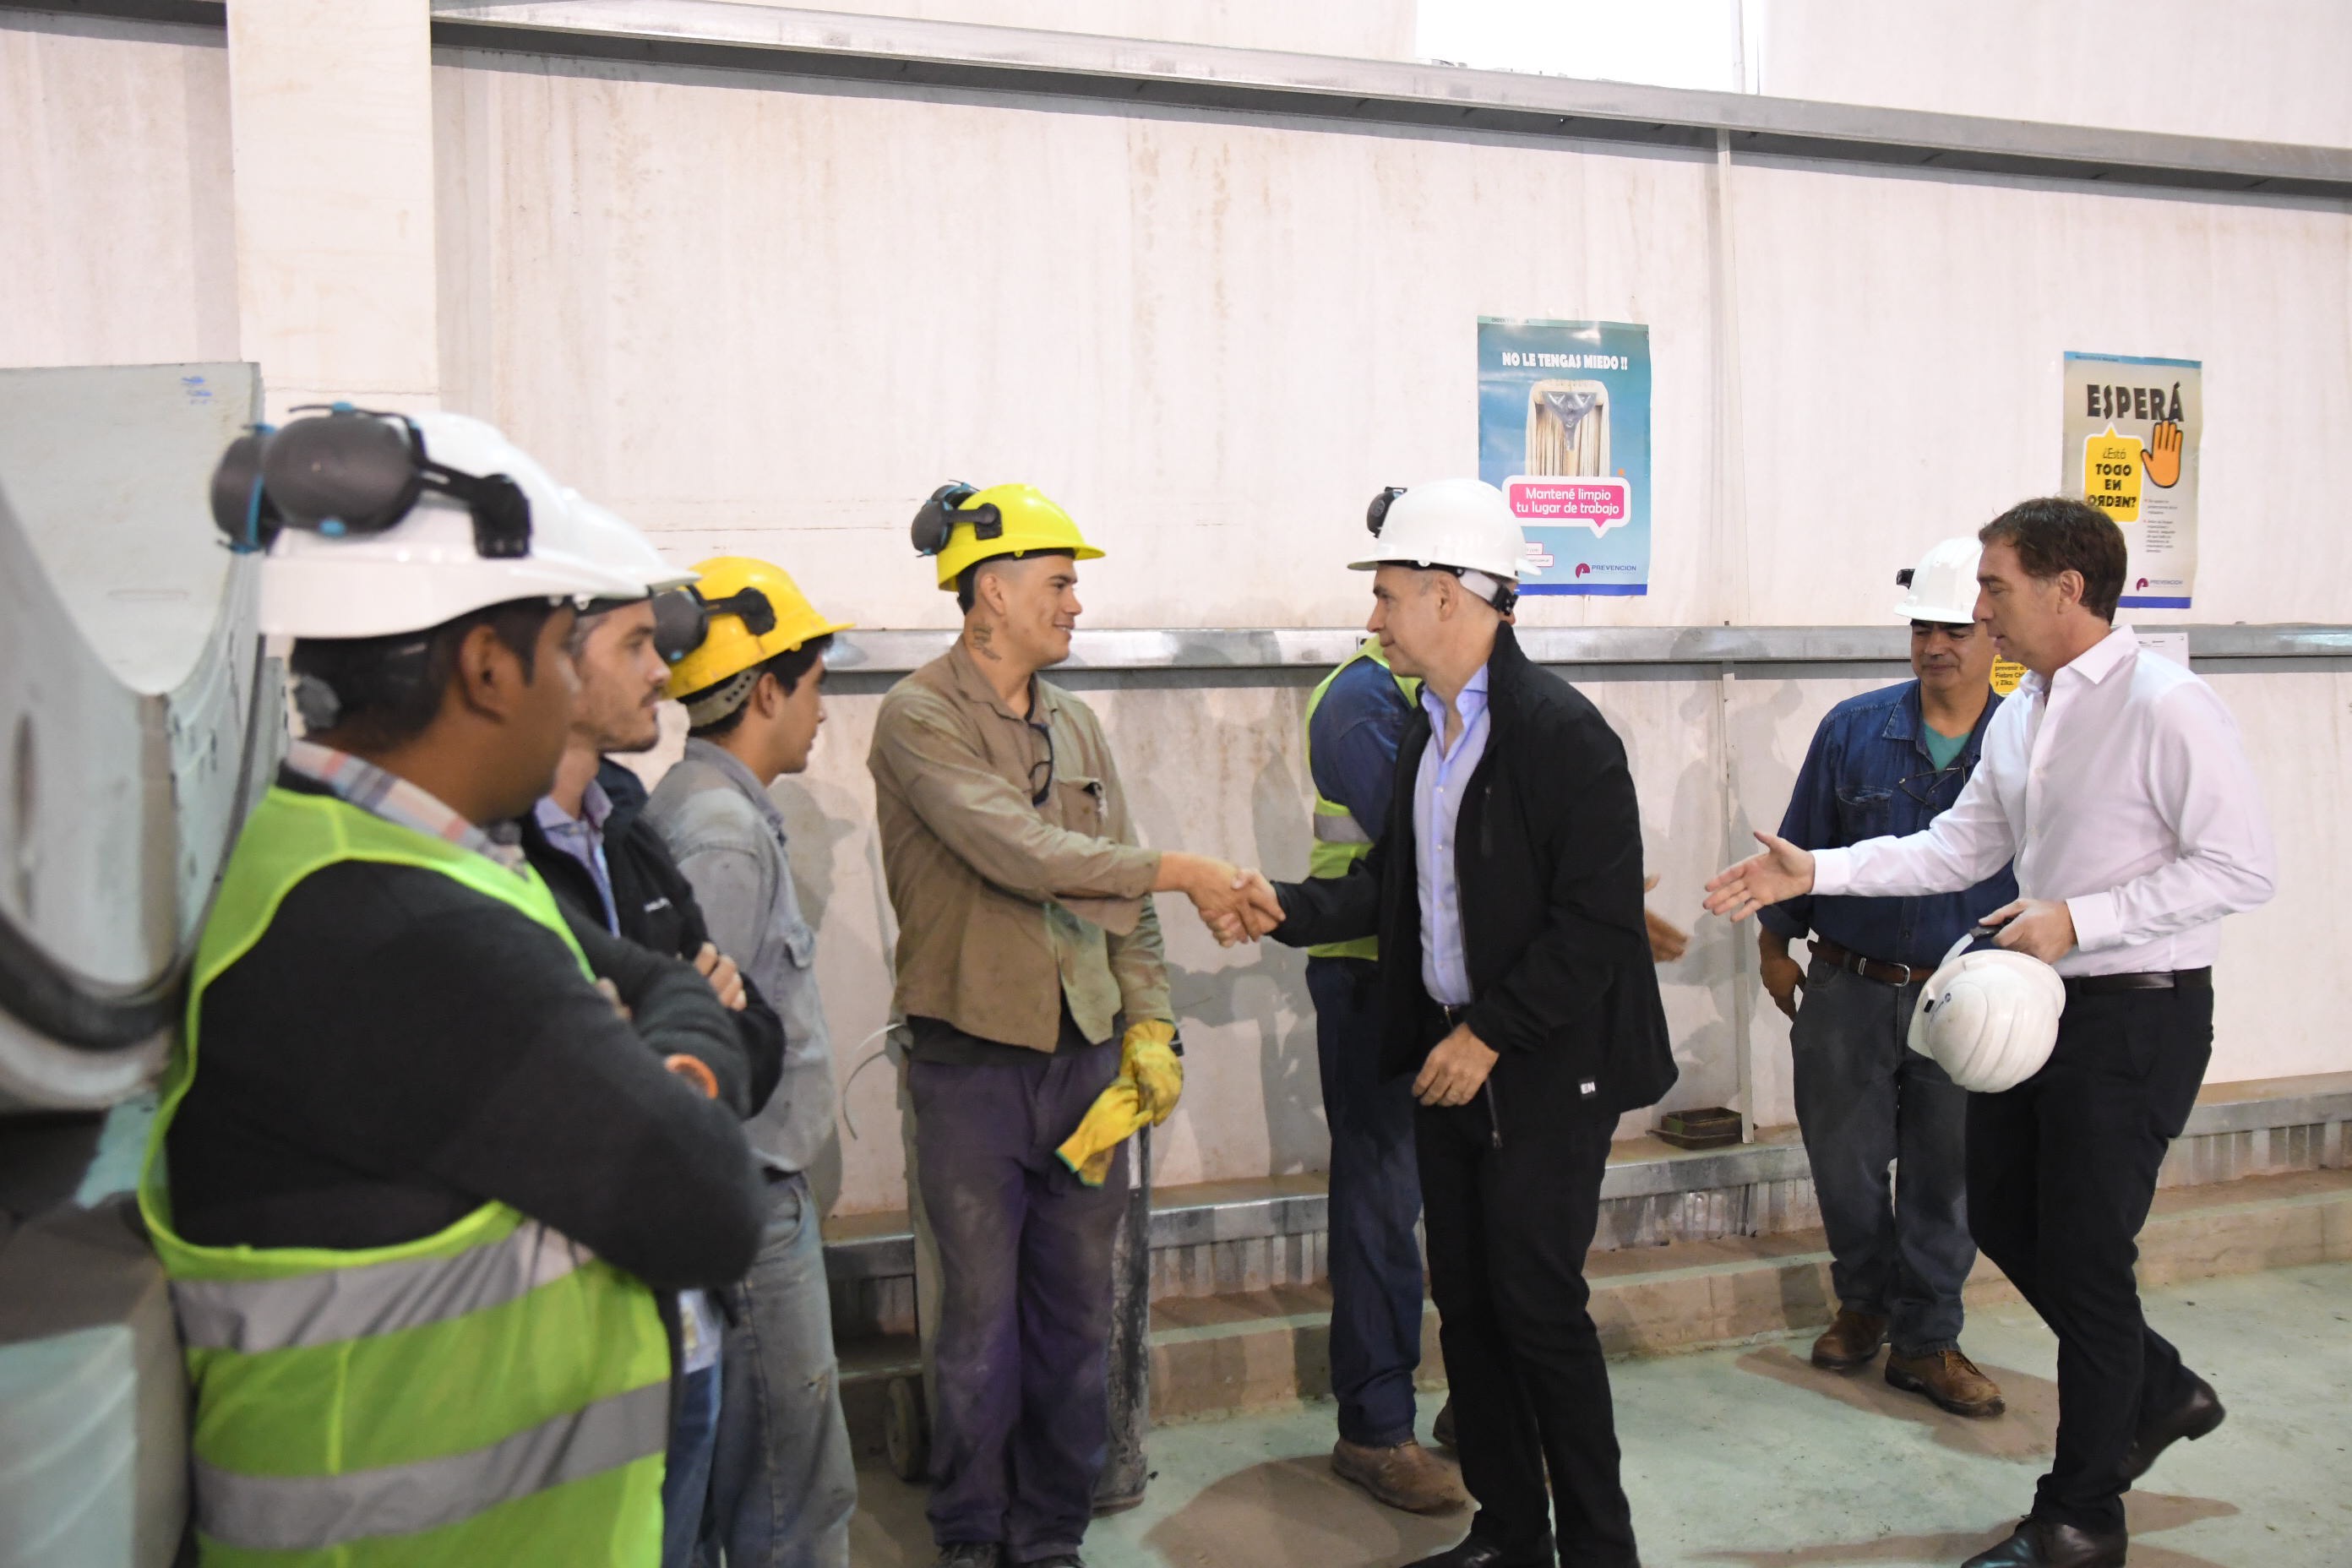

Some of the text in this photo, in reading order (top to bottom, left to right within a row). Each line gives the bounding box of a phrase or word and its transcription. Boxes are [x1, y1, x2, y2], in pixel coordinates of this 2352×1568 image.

[1502, 352, 1520, 366] NO
[1522, 353, 1536, 367] LE
[1538, 353, 1582, 368] TENGAS
[1583, 355, 1619, 369] MIEDO
[2087, 381, 2184, 422] ESPERÁ
[1526, 487, 1611, 502] Mantené limpio
[1516, 501, 1620, 516] tu lugar de trabajo
